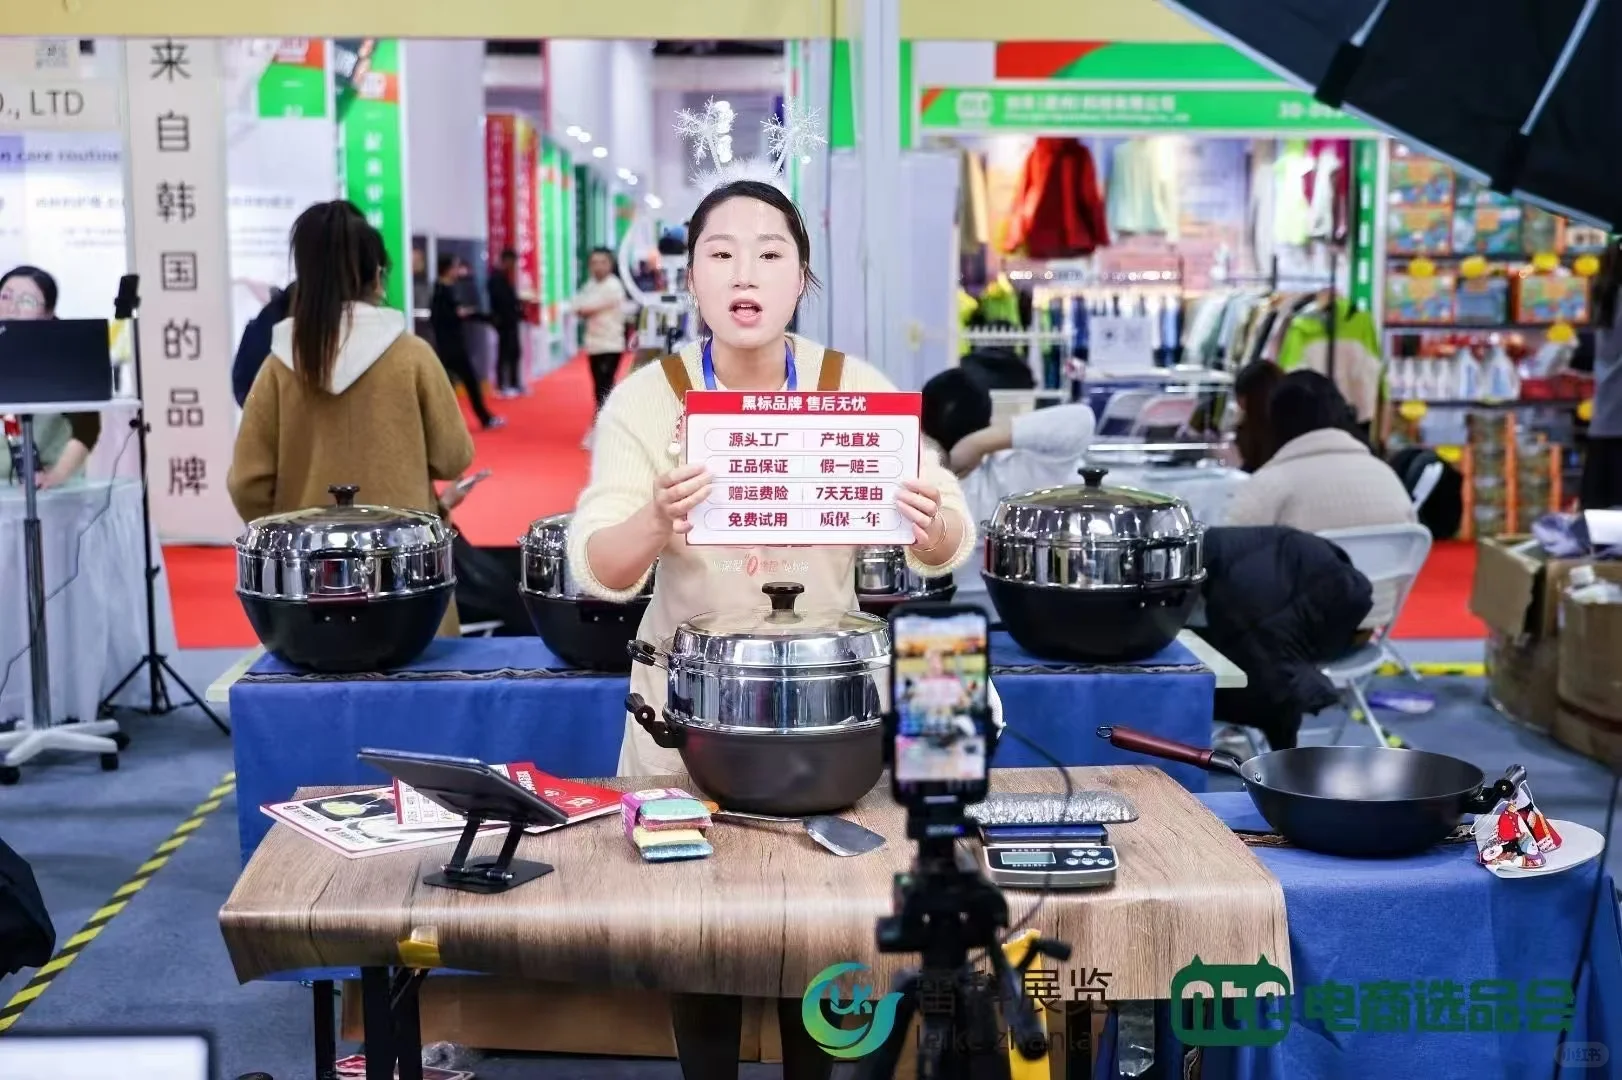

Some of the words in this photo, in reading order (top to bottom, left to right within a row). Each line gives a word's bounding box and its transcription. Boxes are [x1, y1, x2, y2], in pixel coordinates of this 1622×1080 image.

[29, 90, 84, 117] LTD
[150, 37, 208, 496] 来自韩国的品牌
[742, 396, 802, 411] 黑标品牌
[806, 396, 866, 412] 售后无忧
[729, 432, 789, 447] 源头工厂
[820, 432, 880, 447] 产地直发
[729, 459, 789, 474] 正品保证
[820, 459, 880, 474] 假一赔三
[728, 486, 789, 501] 赠运费险
[815, 486, 883, 501] 7天无理由
[728, 512, 788, 527] 免费试用
[820, 512, 880, 527] 质保一年
